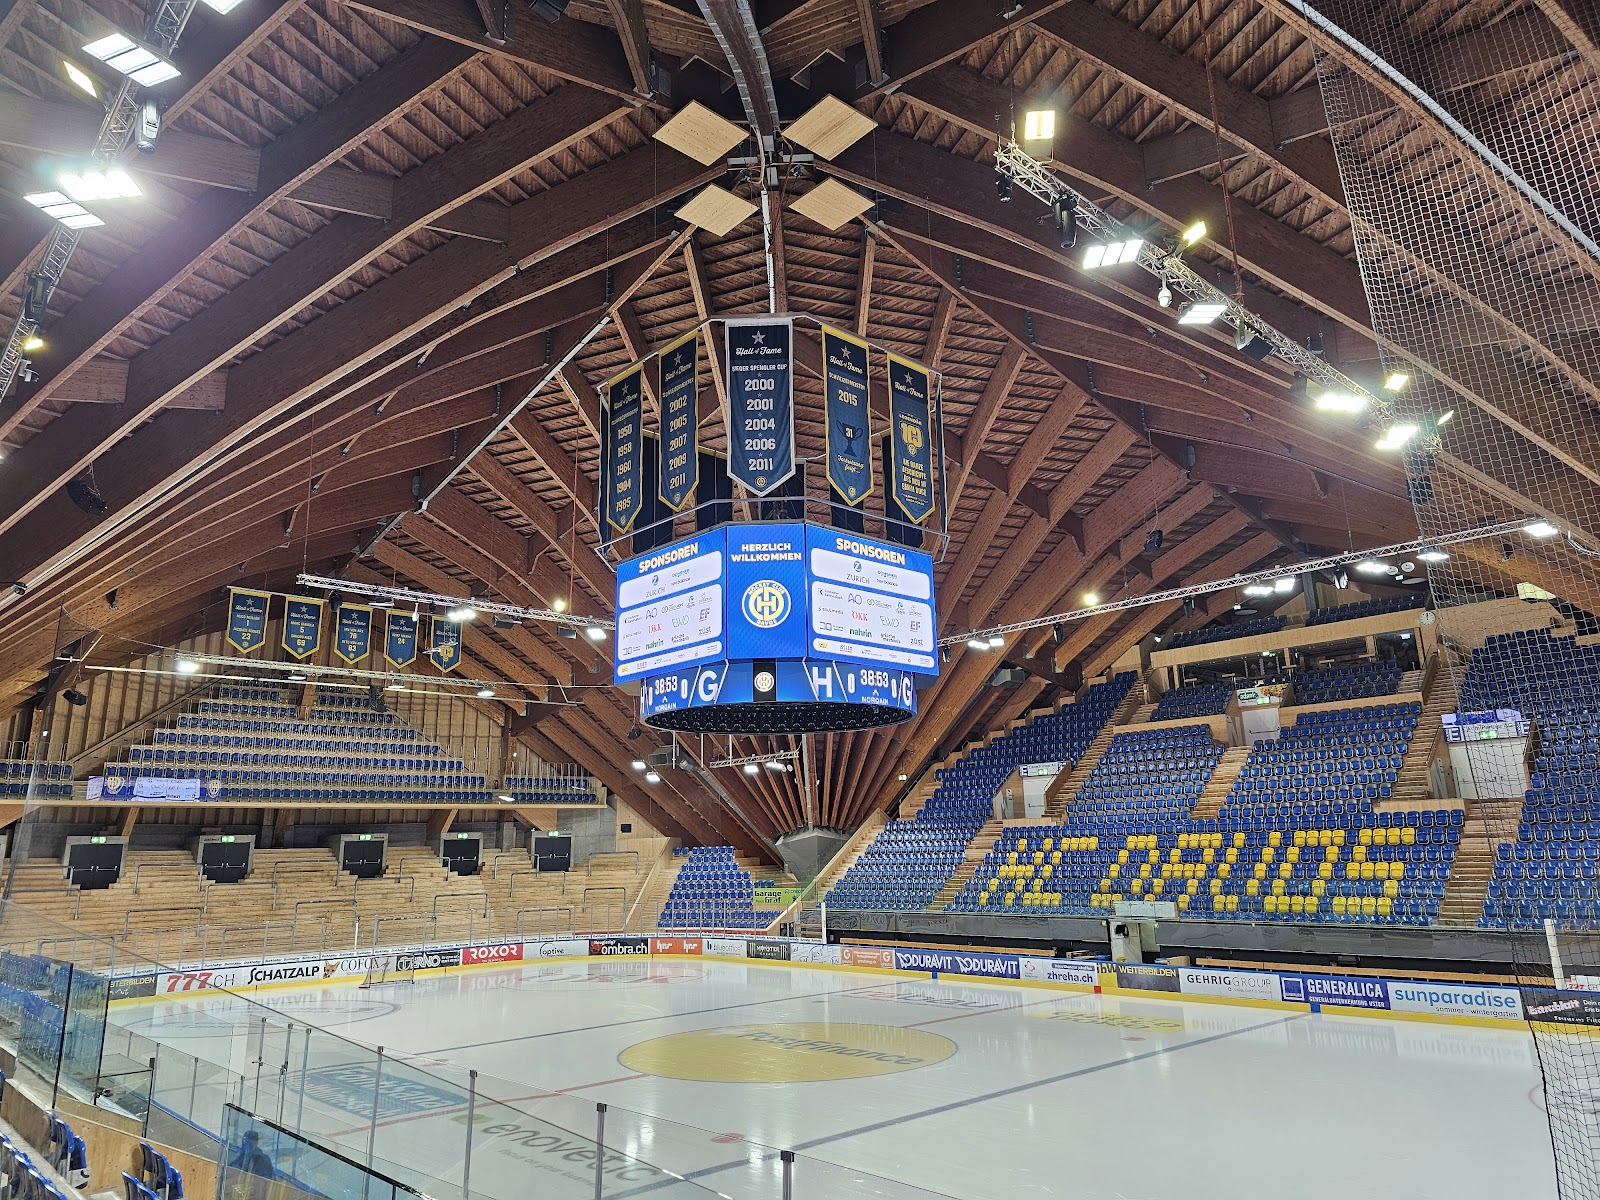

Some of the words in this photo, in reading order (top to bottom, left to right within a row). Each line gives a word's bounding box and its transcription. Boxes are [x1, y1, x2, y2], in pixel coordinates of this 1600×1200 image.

[735, 347, 754, 356] Hall
[760, 346, 782, 355] Fame
[830, 355, 843, 367] Hall
[847, 362, 863, 374] Fame
[744, 378, 775, 391] 2000
[838, 389, 858, 406] 2015
[669, 395, 688, 414] 2002
[746, 398, 774, 411] 2001
[669, 414, 688, 432] 2005
[744, 418, 776, 431] 2004
[618, 423, 633, 440] 1950
[845, 427, 853, 439] 31
[669, 434, 688, 452] 2007
[744, 438, 776, 451] 2006
[617, 442, 632, 458] 1958
[616, 460, 632, 476] 1960
[668, 454, 687, 472] 2009
[748, 458, 773, 471] 2011
[669, 472, 686, 490] 2011
[616, 496, 632, 512] 1985
[741, 543, 791, 552] HERZLICH
[836, 538, 906, 565] SPONSOREN
[638, 542, 699, 574] SPONSOREN
[731, 552, 802, 562] WILLKOMMEN
[847, 573, 869, 584] ZURICH
[645, 587, 665, 598] ZURICH
[748, 582, 770, 595] HOCKEY
[772, 582, 785, 595] CLUB
[848, 592, 862, 605] AO
[645, 607, 658, 620] AO
[910, 620, 921, 631] EF
[849, 628, 873, 638] nahrin
[645, 639, 664, 650] nahrin
[648, 686, 653, 706] 0
[654, 675, 678, 695] 38:53
[681, 678, 688, 699] 0
[698, 670, 719, 702] G
[812, 666, 833, 698] H
[847, 673, 855, 694] 0
[860, 669, 889, 688] 38:53
[891, 678, 897, 698] 0
[902, 677, 912, 707] G
[1088, 828, 1415, 916] DAVOS
[470, 945, 517, 959] ROXOR
[542, 947, 564, 957] optive
[601, 942, 648, 954] ombra.ch
[756, 944, 780, 953] MONSTER
[843, 949, 850, 960] G
[882, 951, 890, 962] G
[912, 953, 952, 970] DURAVIT
[972, 958, 1018, 976] DURAVIT
[1119, 966, 1177, 977] WEITERBILDEN
[110, 976, 155, 988] EITERBILDEN
[166, 972, 235, 992] 777.CH
[247, 966, 320, 985] SCHATZALP
[1047, 971, 1093, 983] zhreha.ch
[1307, 979, 1383, 998] GENERALICA
[1369, 1000, 1385, 1008] USTER
[1395, 987, 1516, 1009] sunparadise
[1470, 1007, 1518, 1018] wintergarten
[738, 1031, 924, 1065] PostFinance
[482, 1124, 661, 1181] enovetic
